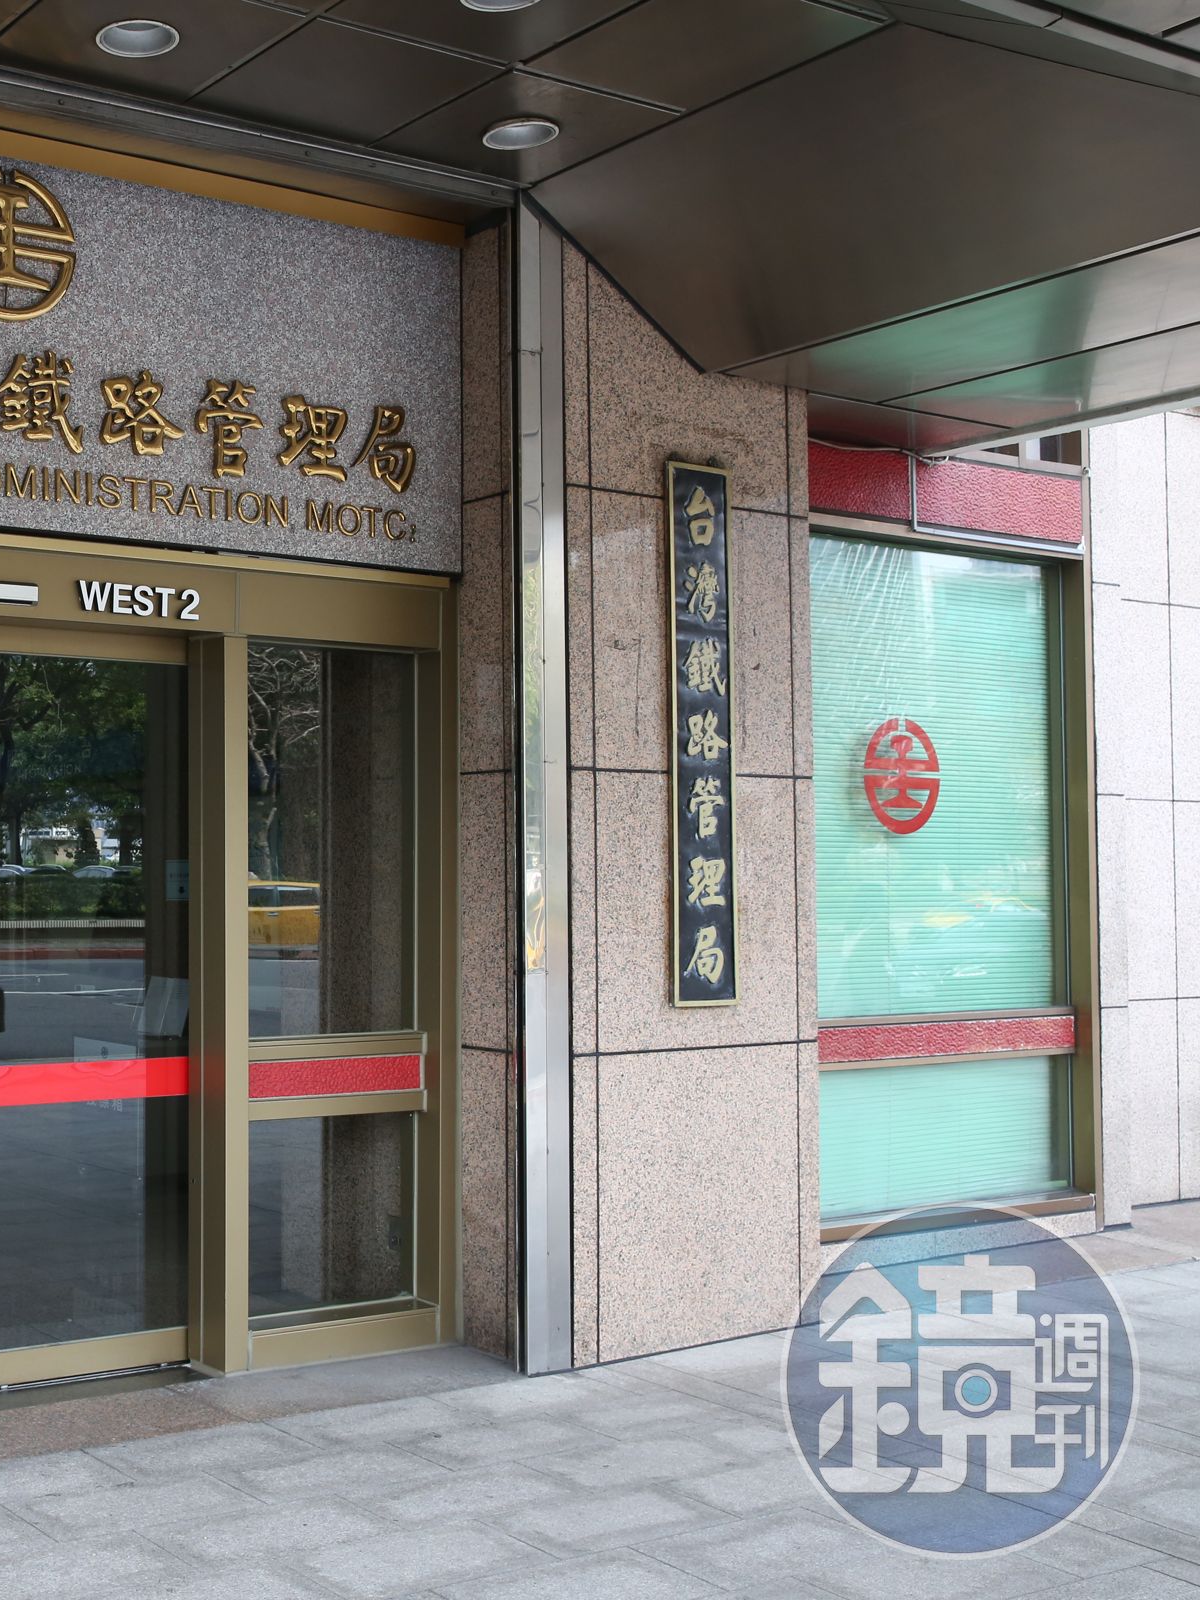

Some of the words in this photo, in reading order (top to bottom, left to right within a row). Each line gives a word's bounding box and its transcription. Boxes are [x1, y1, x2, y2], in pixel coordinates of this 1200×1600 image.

[681, 485, 729, 987] 台灣鐵路管理局
